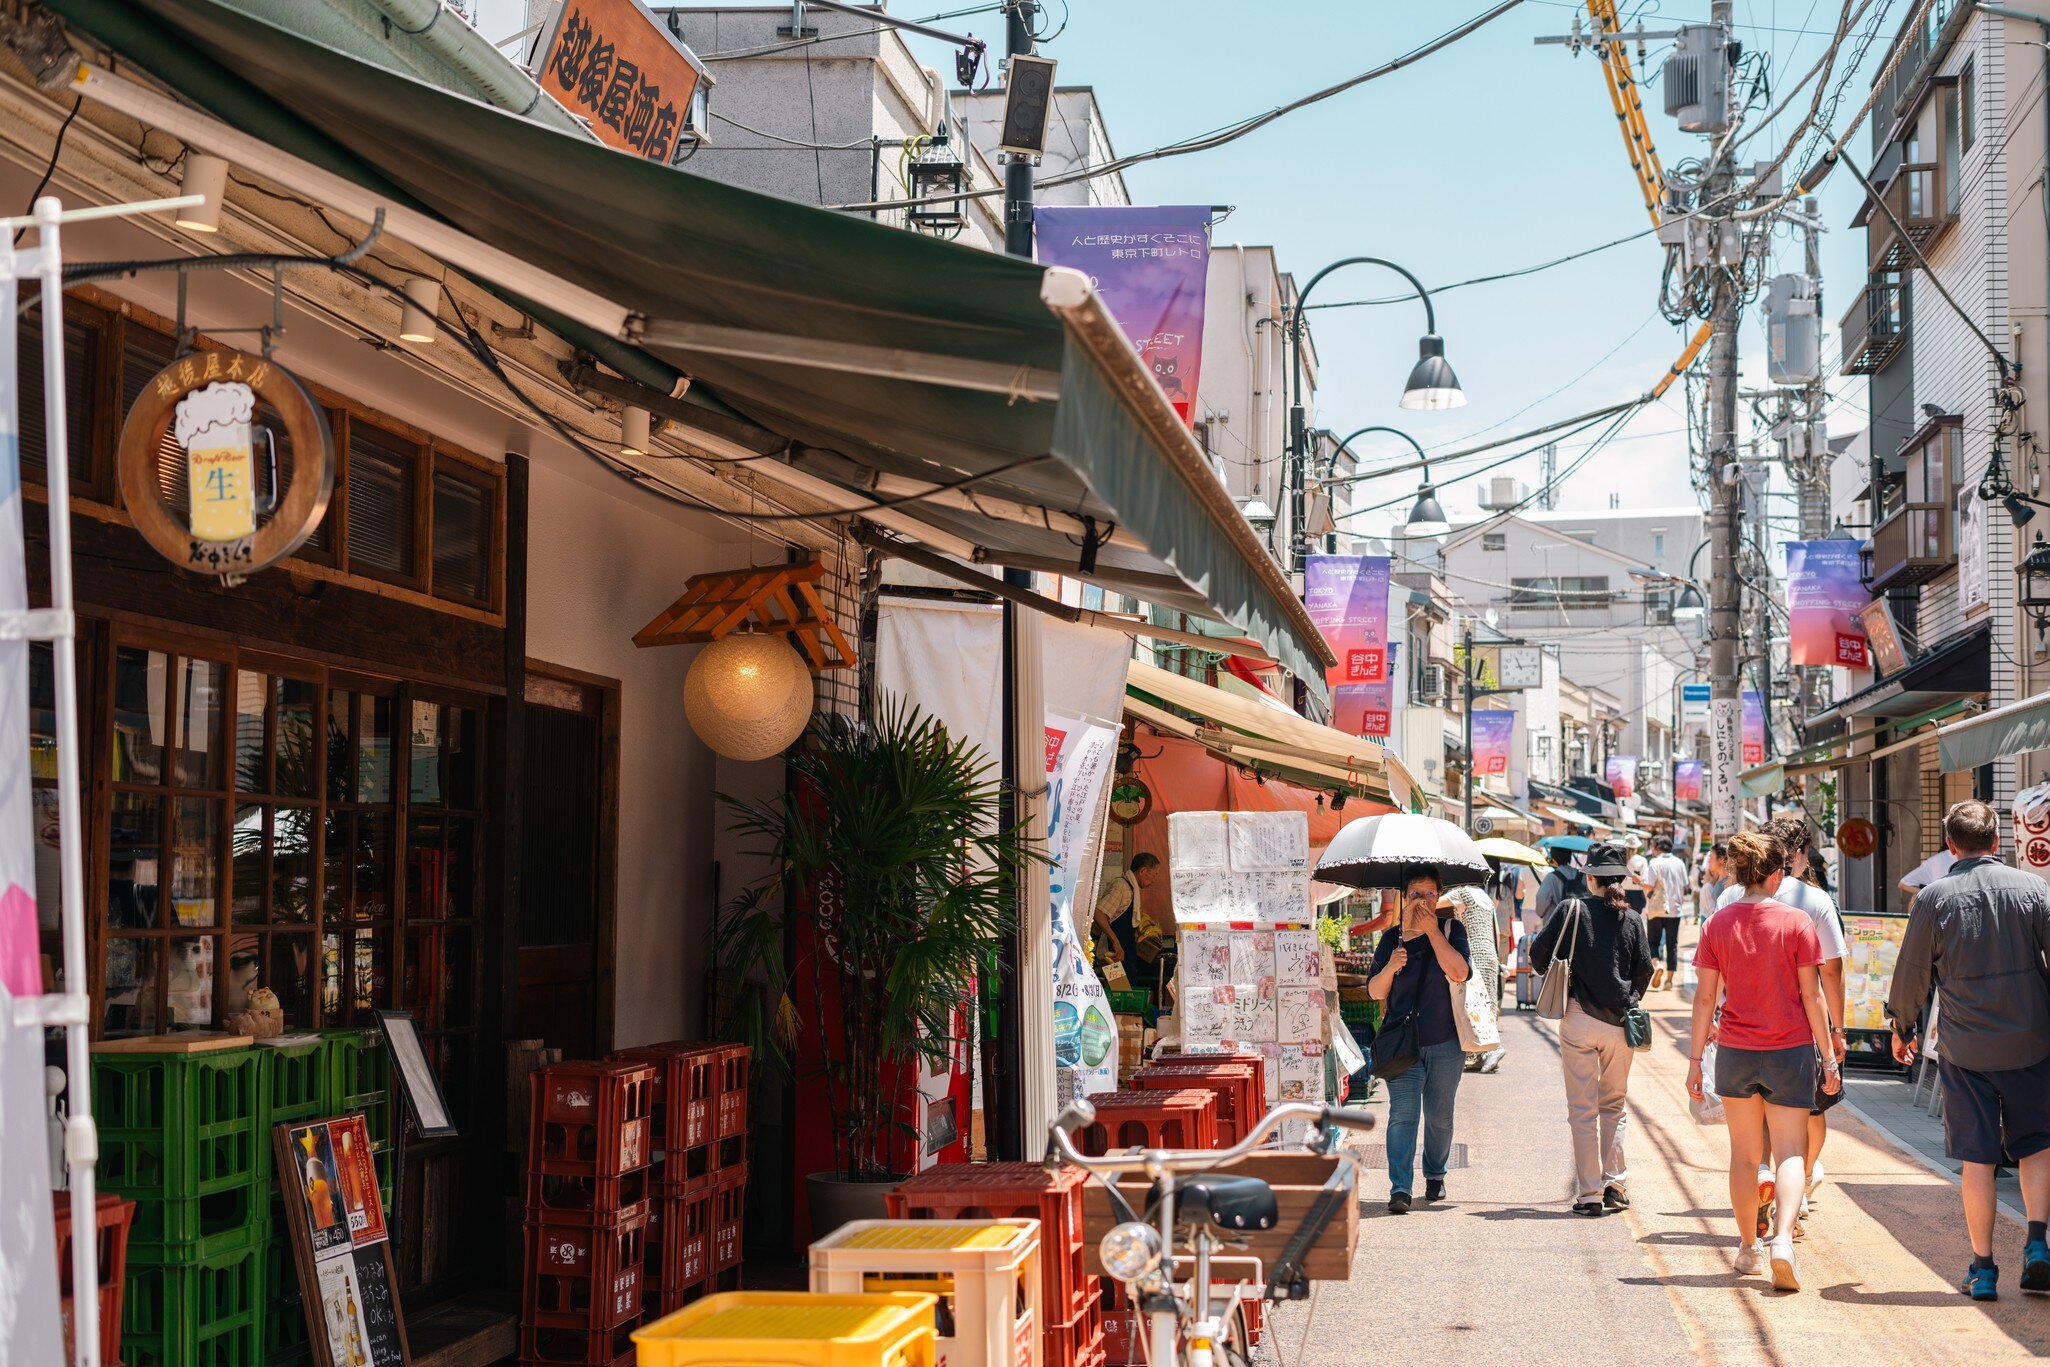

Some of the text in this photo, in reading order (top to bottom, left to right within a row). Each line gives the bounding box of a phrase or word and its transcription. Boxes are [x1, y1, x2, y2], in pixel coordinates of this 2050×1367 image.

[549, 7, 677, 162] 越後屋酒店
[1111, 247, 1201, 259] 東京下町レトロ
[1135, 334, 1185, 352] STEET
[205, 467, 237, 502] 生
[1308, 586, 1335, 595] TOKYO
[1308, 602, 1338, 610] YANAKA
[1312, 615, 1379, 625] HOPPING STREET
[1350, 652, 1379, 666] 谷中
[1349, 664, 1379, 677] ぎんざ
[1366, 713, 1387, 723] 谷中
[1716, 719, 1730, 793] しにものぐるい
